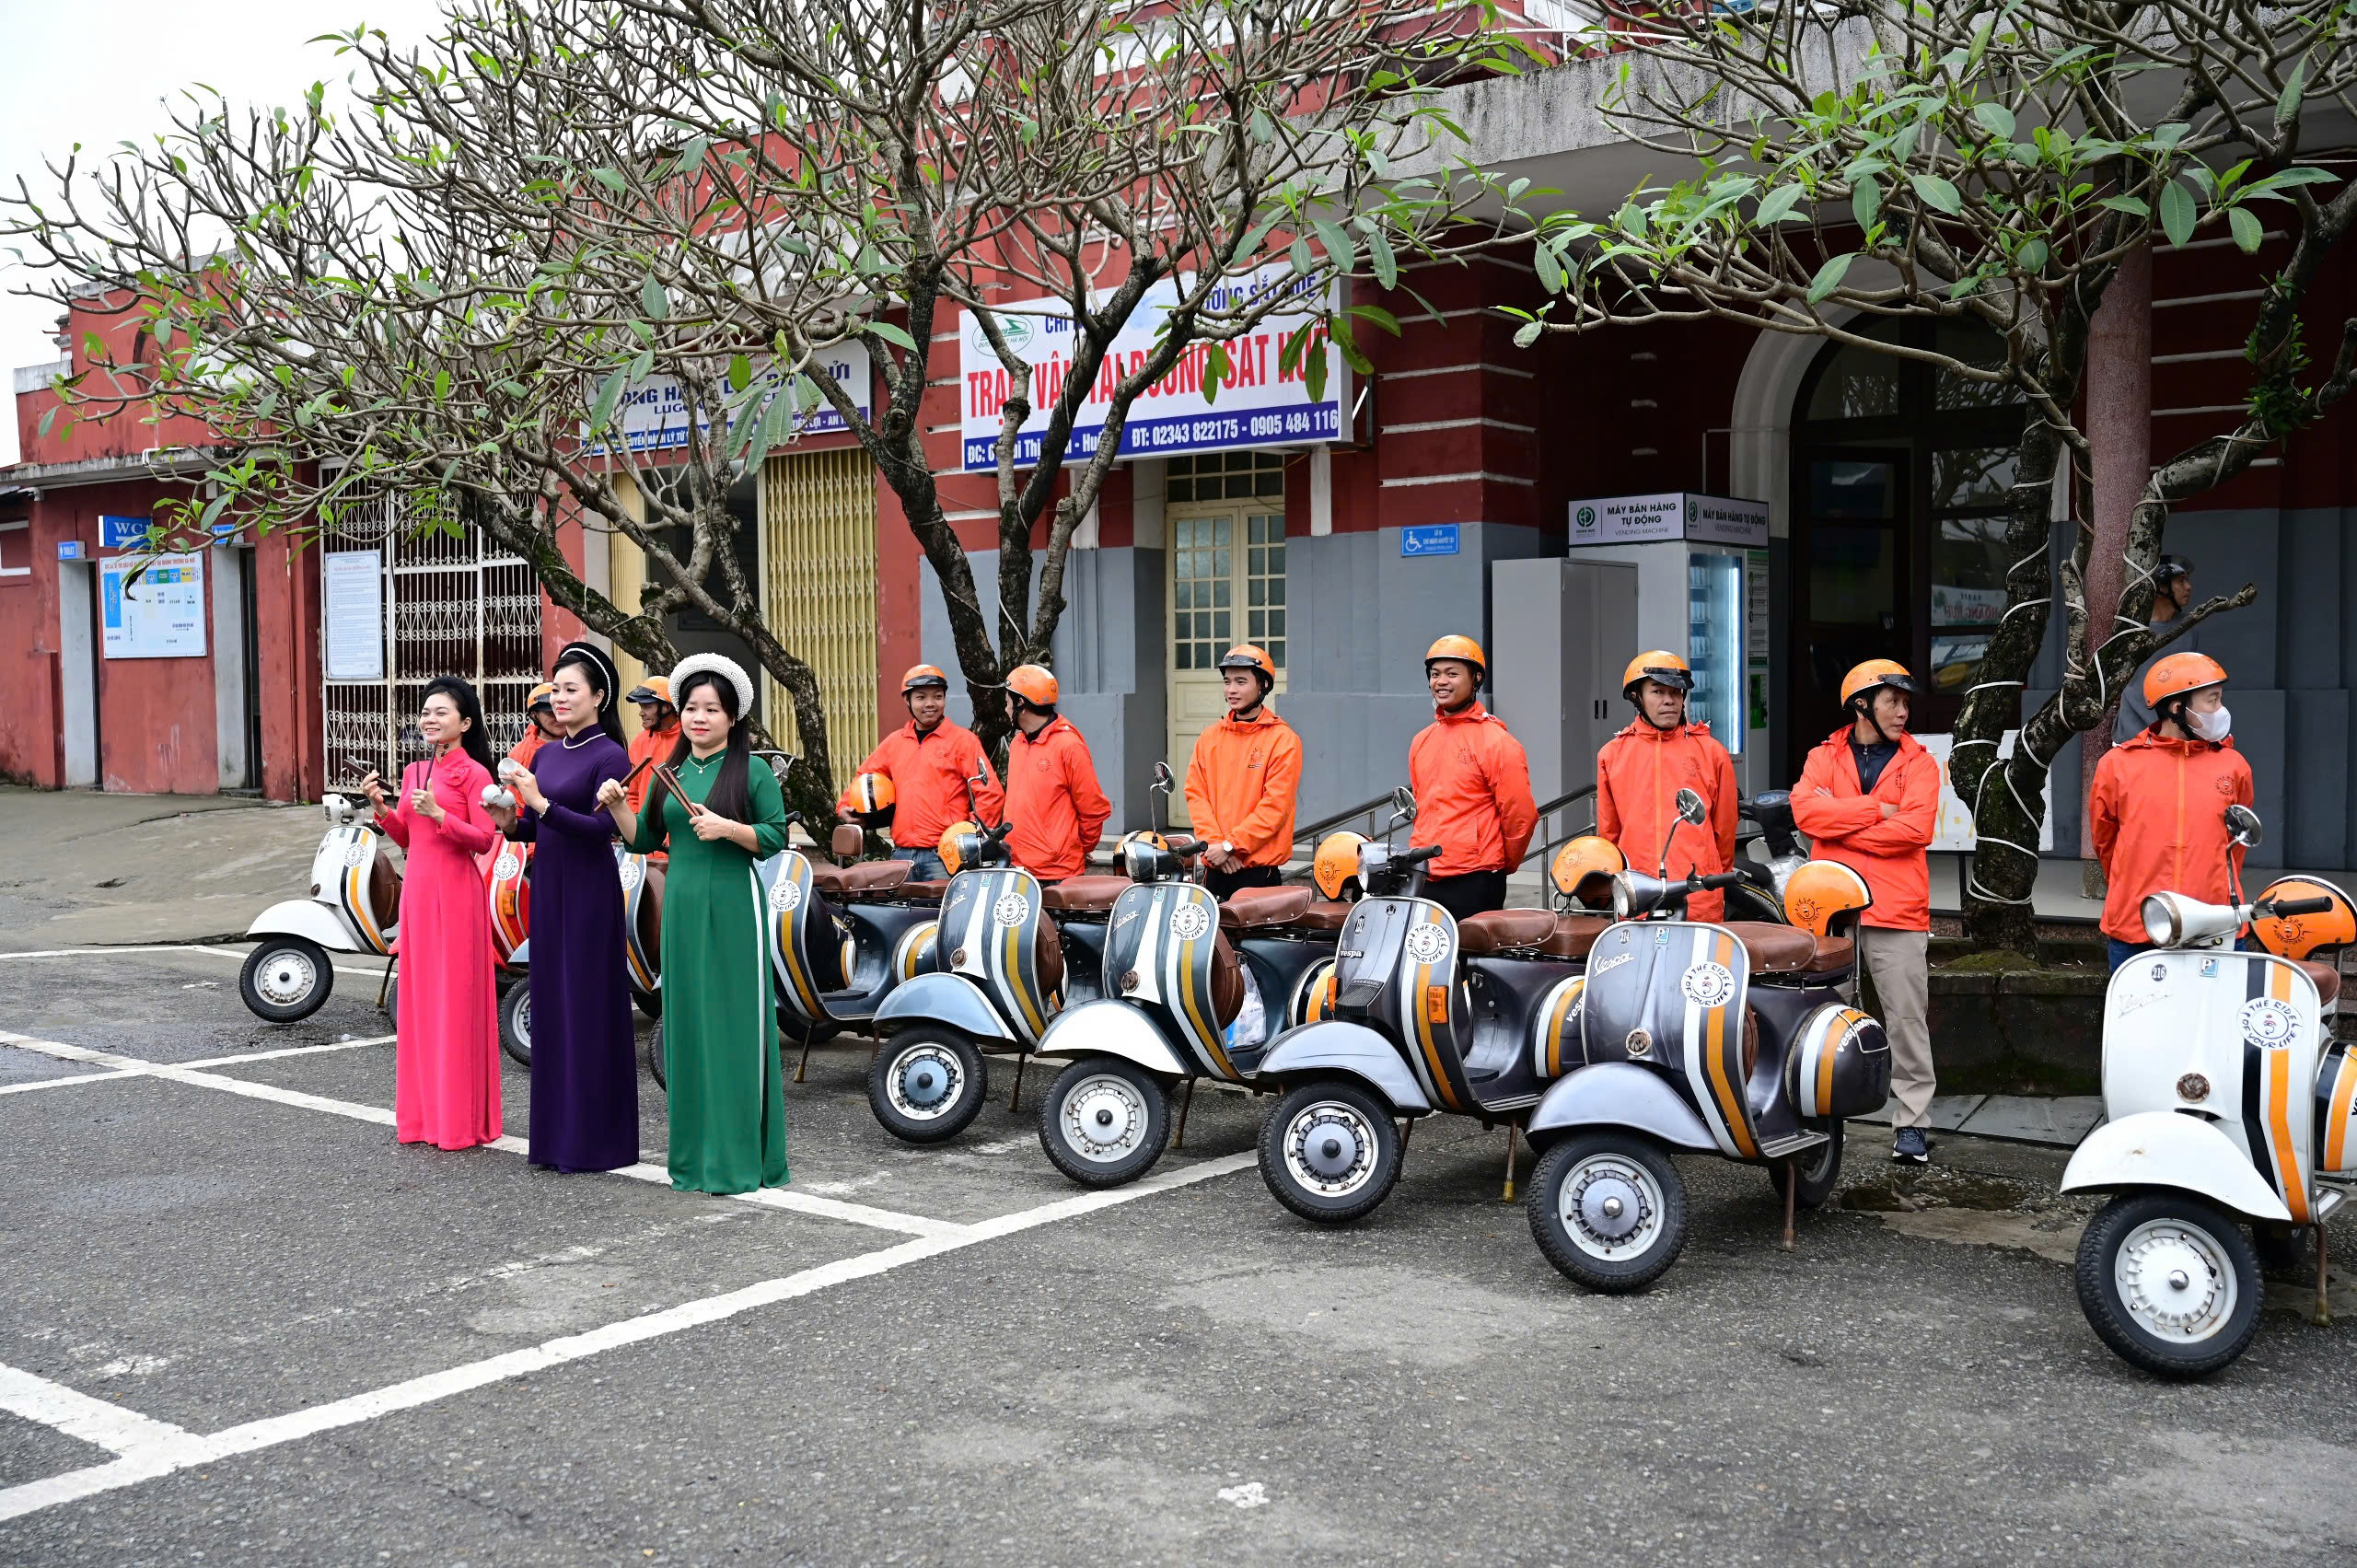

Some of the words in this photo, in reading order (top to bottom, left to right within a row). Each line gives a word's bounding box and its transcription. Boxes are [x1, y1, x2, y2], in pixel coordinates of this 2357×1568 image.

[829, 359, 851, 381] ỬI
[968, 445, 986, 464] ĐC:
[1132, 427, 1150, 447] ĐT:
[1153, 423, 1190, 446] 02343
[1192, 419, 1238, 442] 822175
[1250, 414, 1283, 437] 0905
[1285, 411, 1310, 433] 484
[1314, 408, 1339, 431] 116
[1607, 505, 1628, 516] MÁY
[1629, 503, 1648, 515] BÁN
[1650, 502, 1677, 513] HÀNG
[1703, 508, 1715, 520] MÁY
[1716, 510, 1727, 521] BÁN
[1728, 511, 1743, 523] HÀNG
[1749, 513, 1766, 527] ĐỘNG
[1621, 517, 1632, 528] TỰ
[1634, 514, 1662, 526] ĐỘNG
[1615, 528, 1642, 537] VENDING
[1643, 527, 1669, 535] MACHINE
[1414, 924, 1430, 934] THE
[1432, 926, 1446, 941] RIDE
[1340, 949, 1363, 958] vespa
[1410, 949, 1428, 963] YOUR
[1429, 948, 1444, 962] LIFE
[1594, 952, 1635, 977] Vespa
[1691, 963, 1708, 974] THE
[1712, 964, 1730, 981] RIDE
[2152, 967, 2165, 979] 216
[1685, 981, 1692, 992] OF
[1689, 993, 1712, 1005] YOUR
[1713, 989, 1729, 1005] LIFE
[2248, 999, 2270, 1012] THE
[2273, 1001, 2297, 1020] RIDE
[2241, 1018, 2251, 1032] OF
[2247, 1032, 2277, 1049] YOUR
[2279, 1029, 2297, 1048] LIFE
